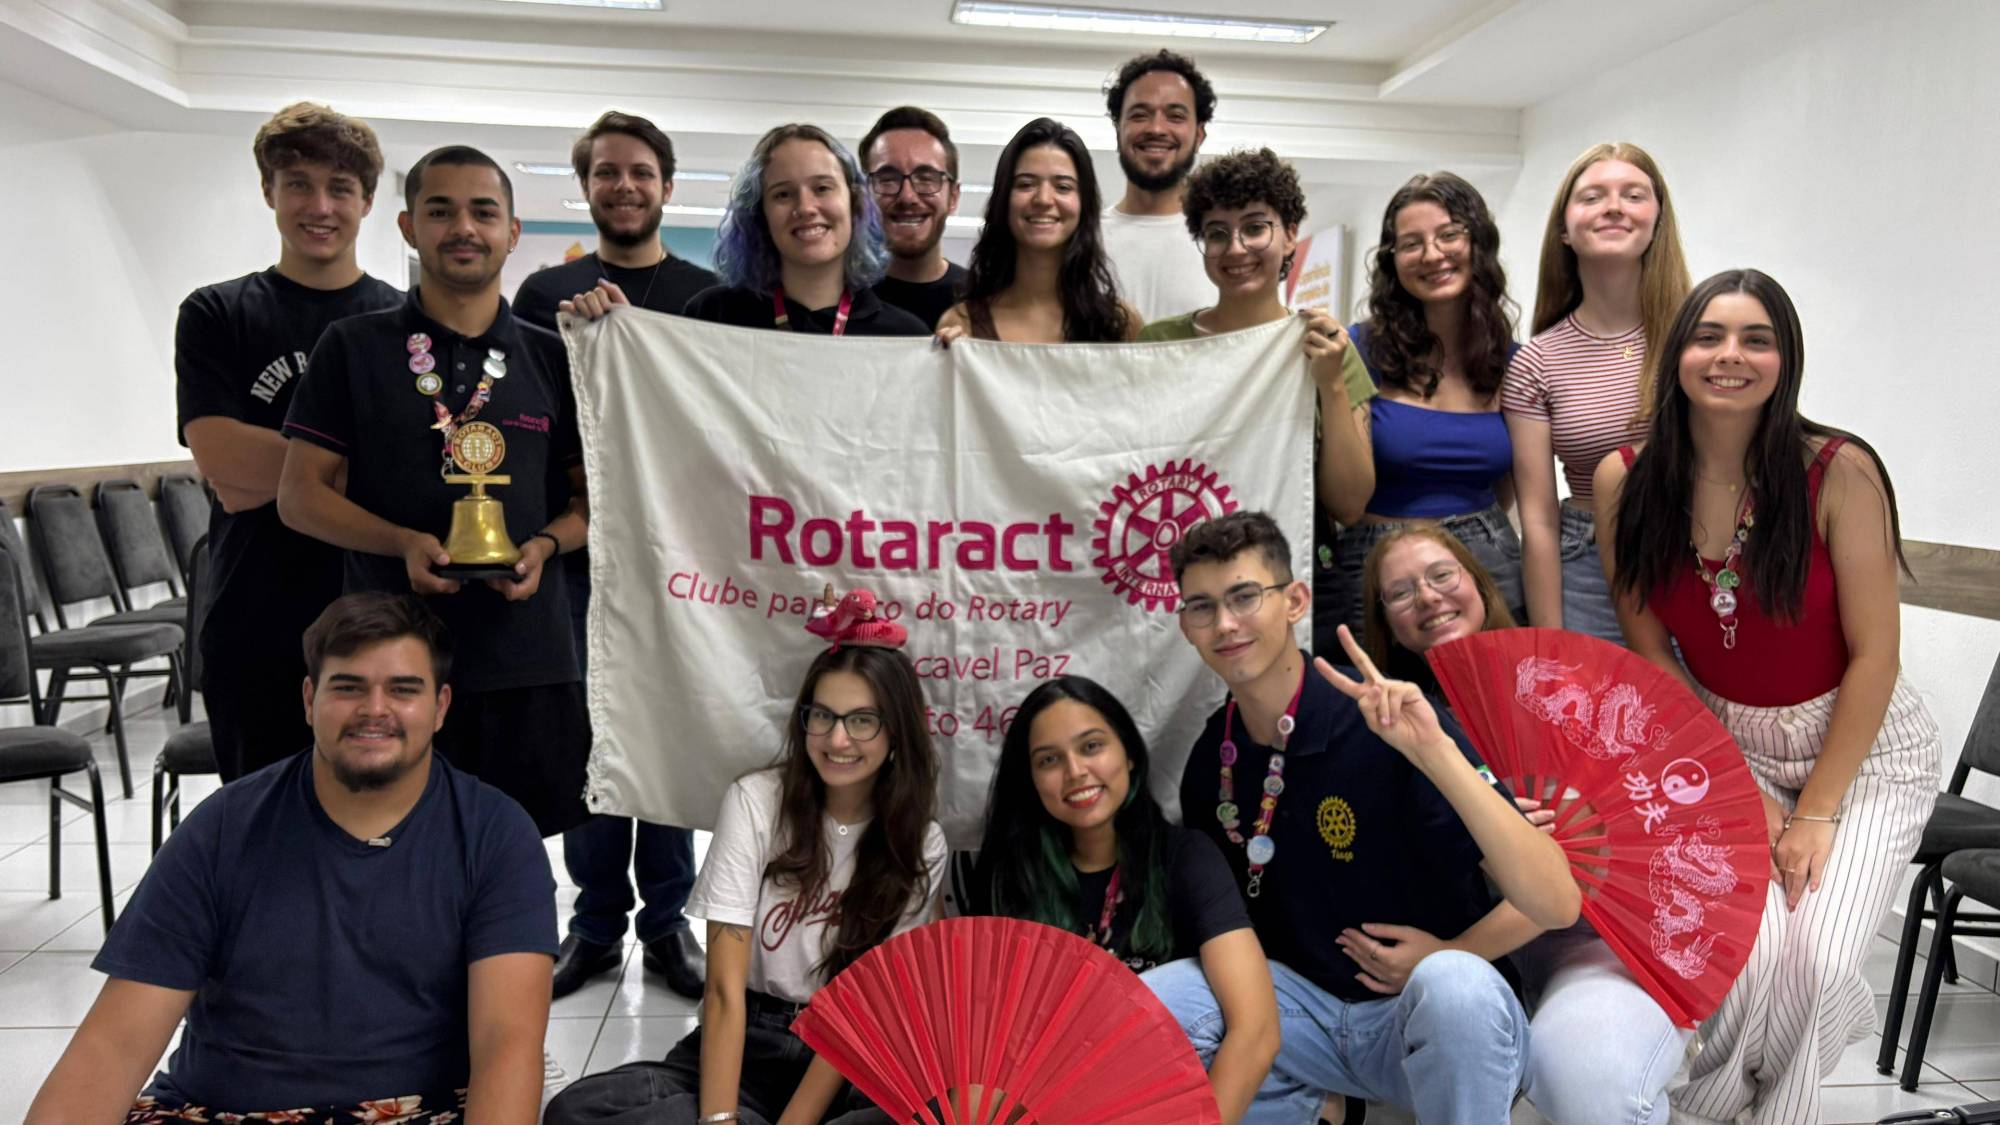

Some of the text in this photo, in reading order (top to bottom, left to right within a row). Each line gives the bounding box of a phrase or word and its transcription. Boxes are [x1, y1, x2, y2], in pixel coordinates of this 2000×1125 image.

[250, 355, 293, 404] NEW
[1137, 475, 1197, 500] ROTARY
[749, 495, 1074, 572] Rotaract
[667, 572, 758, 608] Clube
[916, 592, 955, 620] do
[967, 595, 1072, 628] Rotary
[1118, 567, 1177, 597] INTERNA
[914, 646, 1072, 681] cavel Paz
